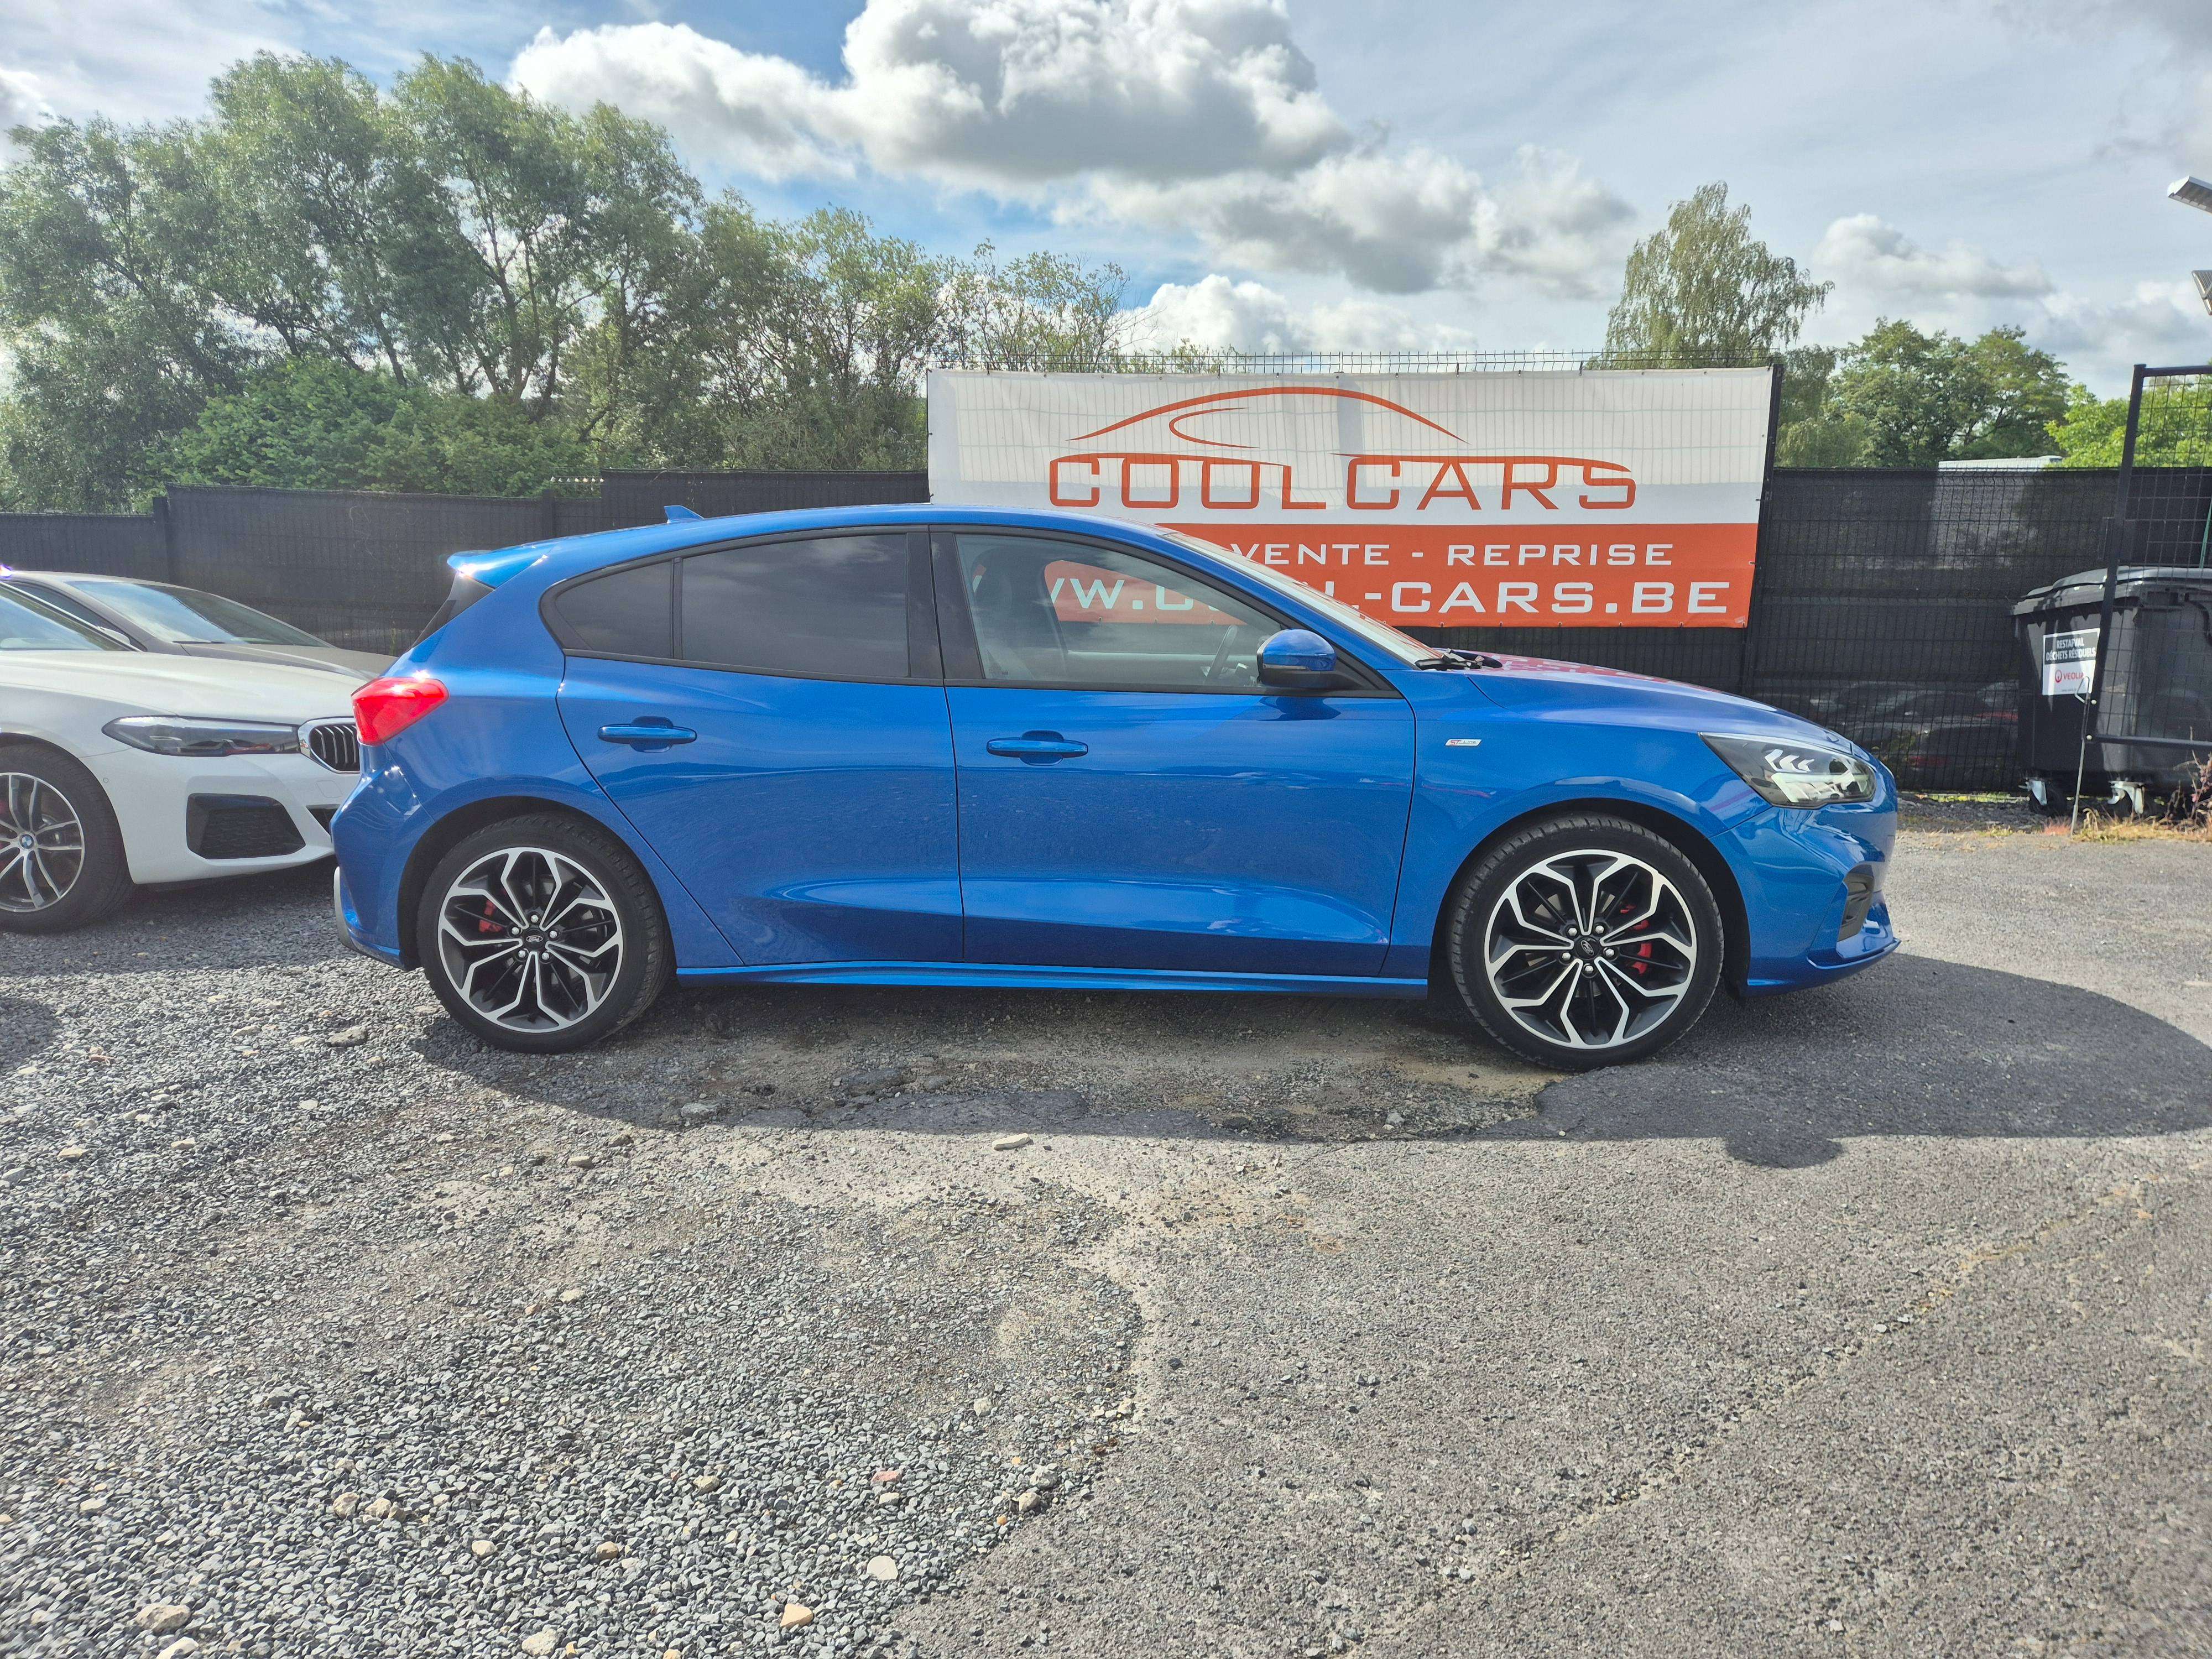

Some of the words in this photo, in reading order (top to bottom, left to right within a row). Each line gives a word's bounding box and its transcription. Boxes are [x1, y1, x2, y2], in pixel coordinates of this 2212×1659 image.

[1230, 543, 1390, 565] VENTE
[1447, 544, 1673, 566] REPRISE
[2057, 637, 2085, 649] RESTAFVAL
[2046, 650, 2068, 661] DÉCHETS
[2068, 646, 2096, 659] RÉSIDUELS
